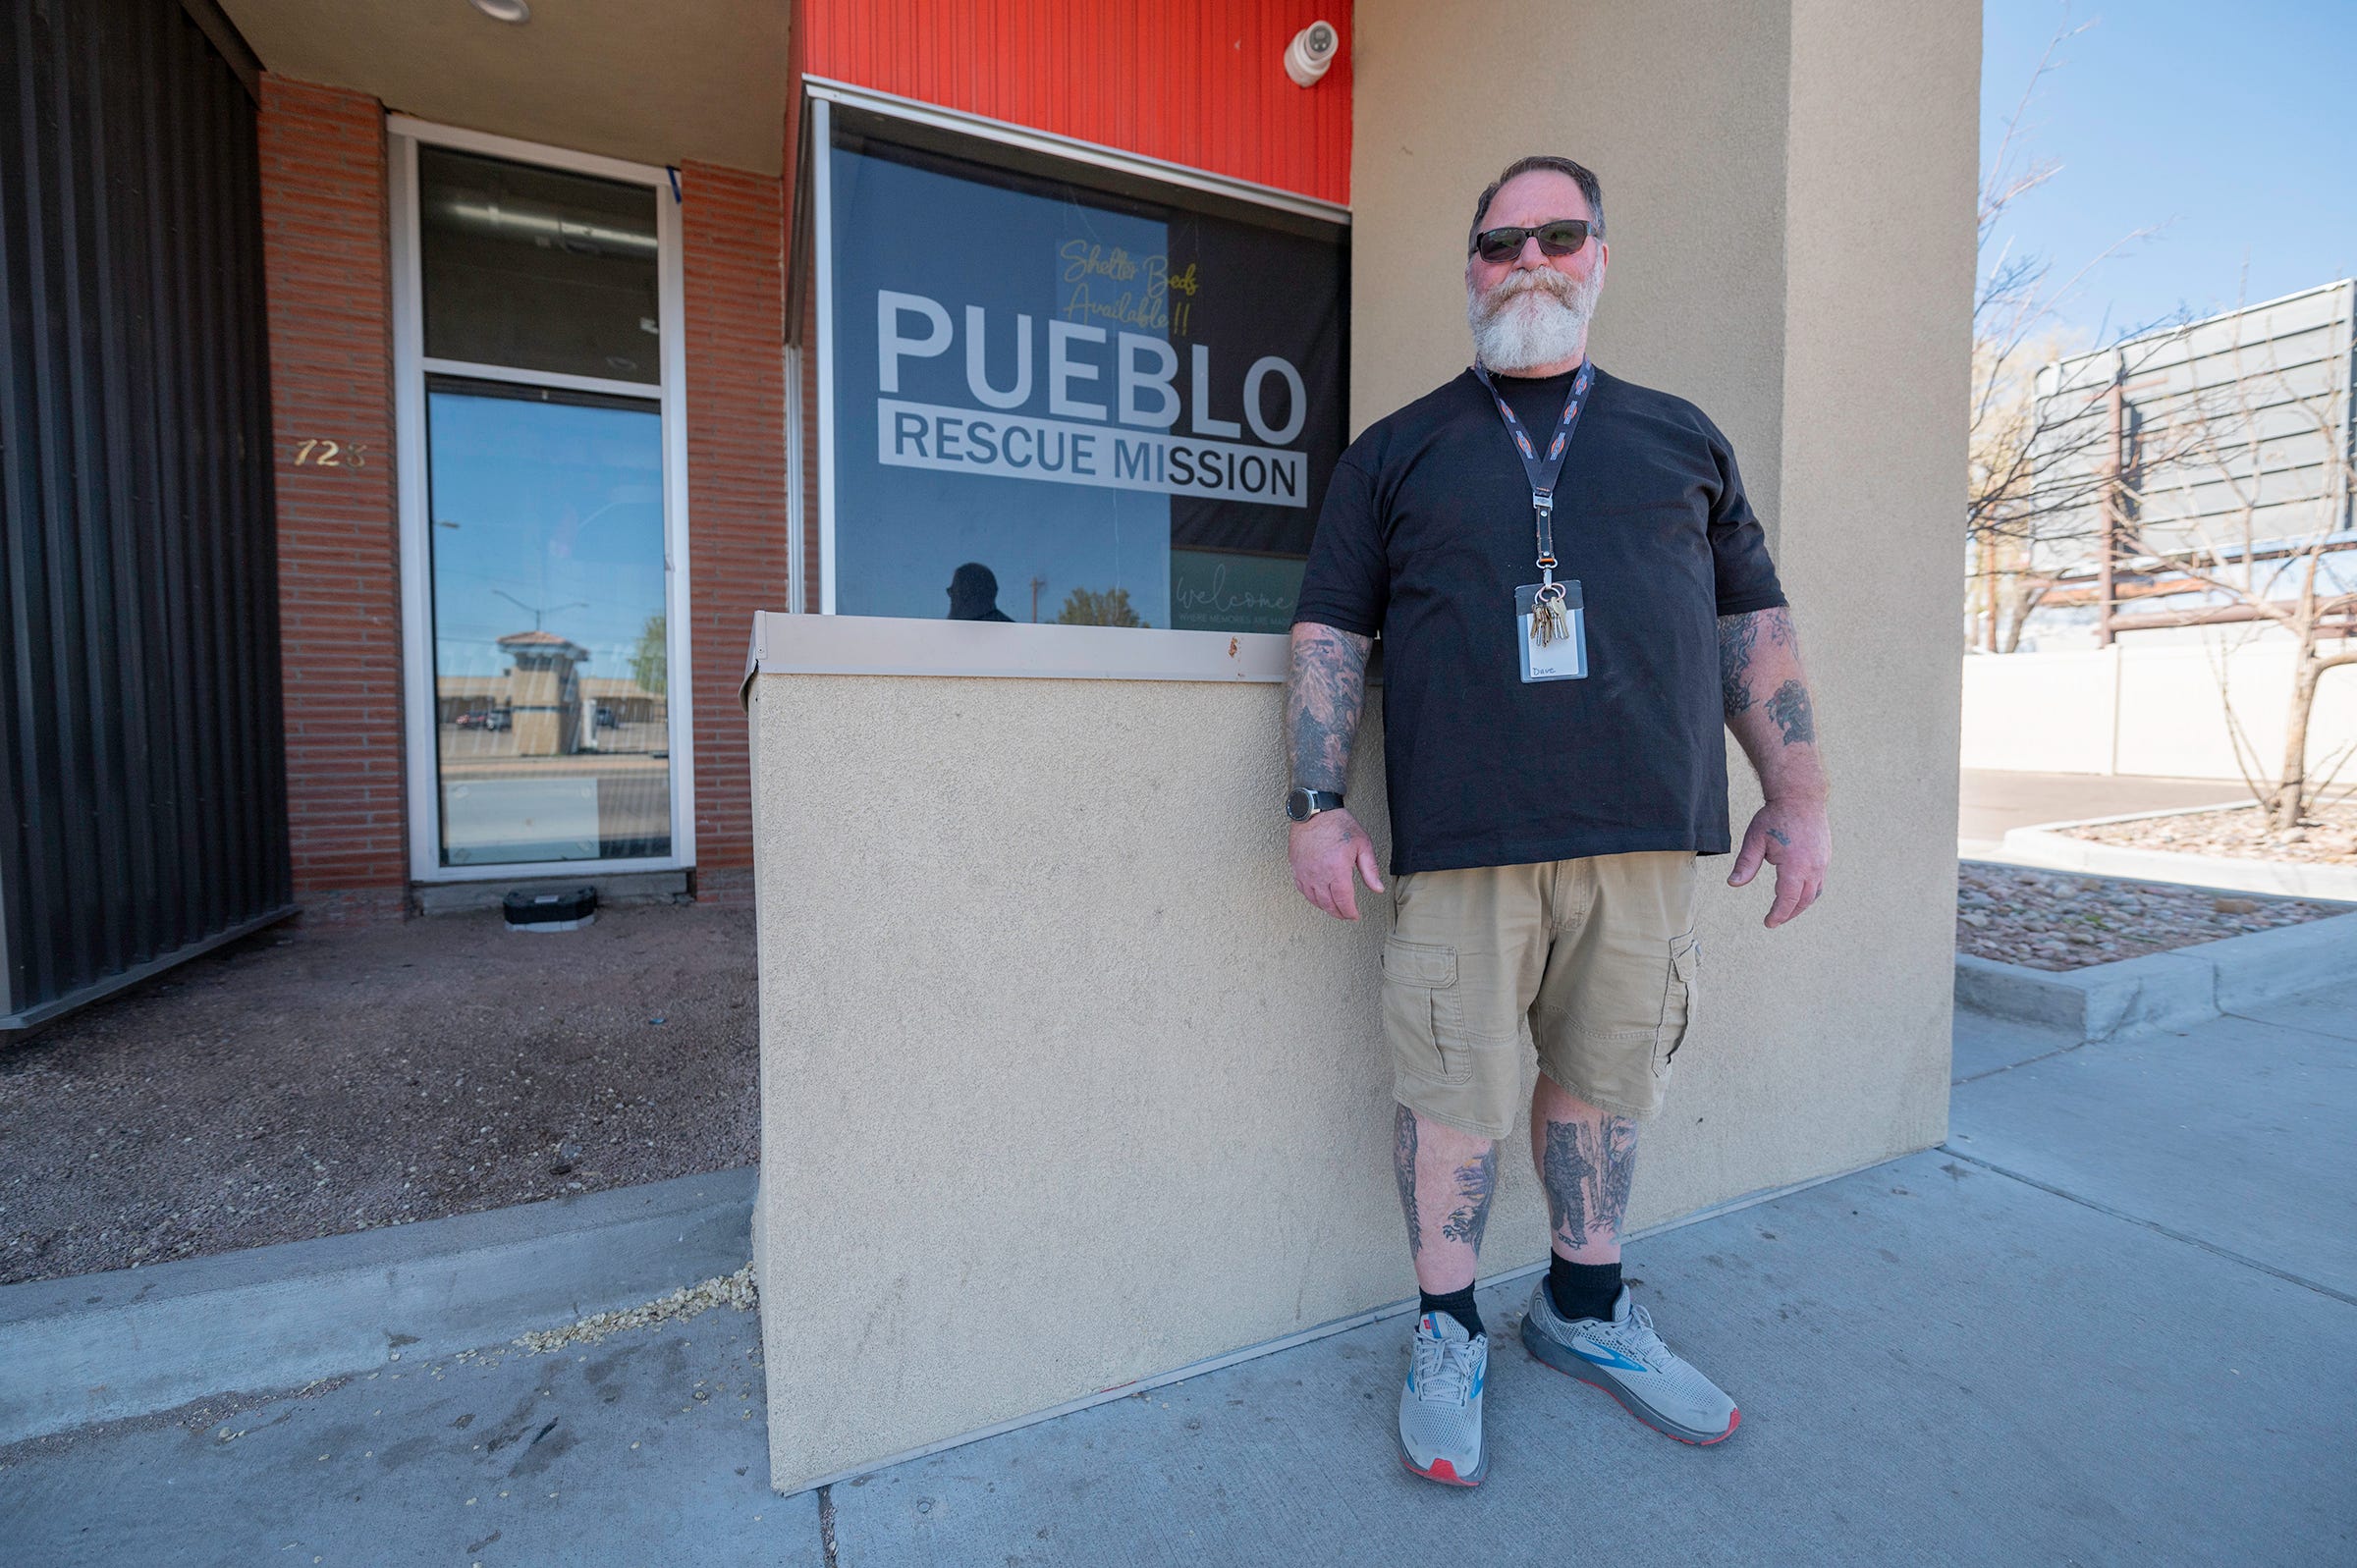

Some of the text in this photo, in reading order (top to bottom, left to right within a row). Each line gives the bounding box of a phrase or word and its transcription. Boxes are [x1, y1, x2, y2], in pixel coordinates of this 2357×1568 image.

[1060, 239, 1199, 298] Shelter Beds
[878, 290, 1307, 446] PUEBLO
[895, 410, 1296, 497] RESCUE MISSION
